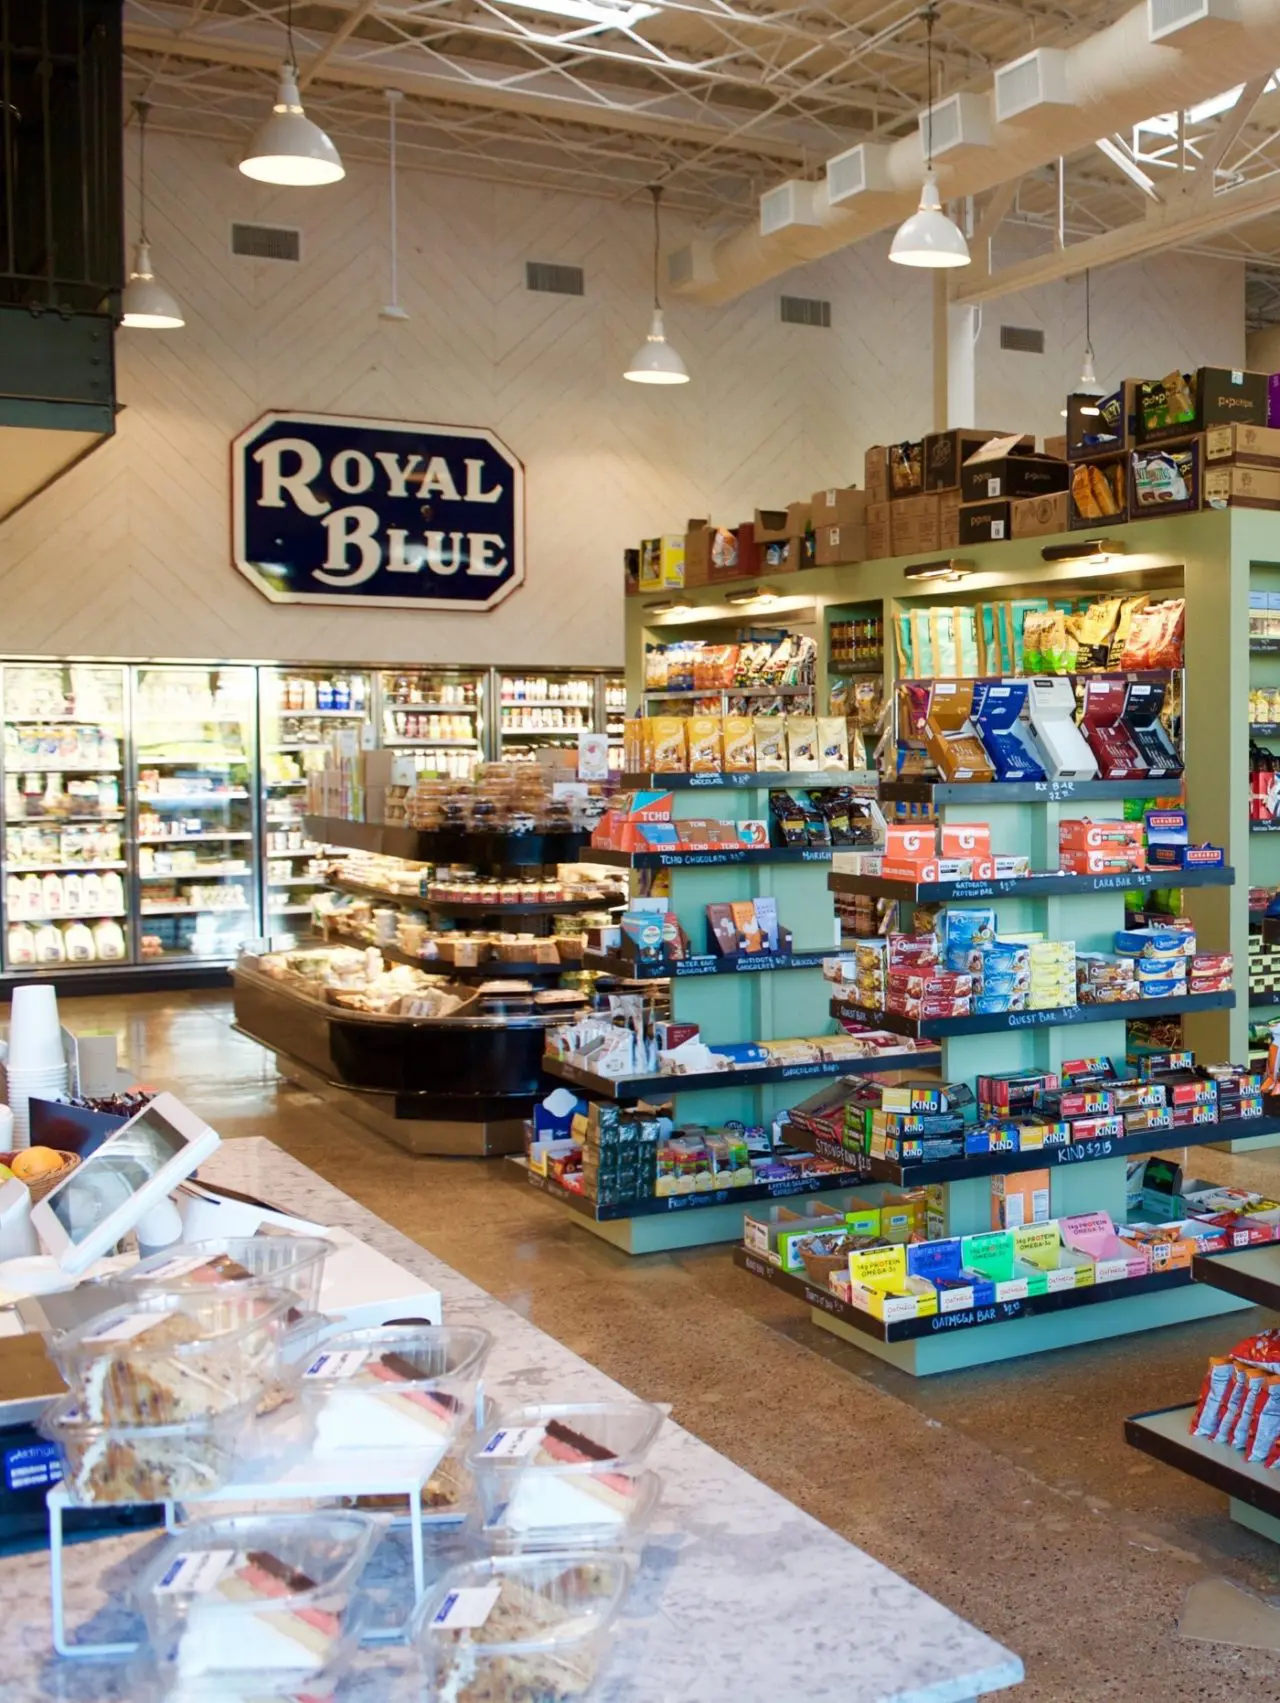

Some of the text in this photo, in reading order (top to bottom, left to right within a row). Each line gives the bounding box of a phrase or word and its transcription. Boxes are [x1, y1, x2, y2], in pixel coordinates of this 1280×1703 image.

[252, 438, 503, 516] ROYAL
[311, 505, 508, 587] BLUE
[1052, 782, 1075, 791] BAR
[641, 811, 670, 822] TCHO
[661, 855, 682, 865] TCHO
[1094, 878, 1131, 888] LARA BAR
[1008, 1011, 1056, 1026] QUEST BAR
[1086, 1062, 1109, 1071] KIND
[1170, 1060, 1192, 1070] KIND
[1239, 1083, 1262, 1096] KIND
[1138, 1094, 1163, 1105] KIND
[1195, 1091, 1218, 1101] KIND
[911, 1100, 938, 1111] KIND
[1085, 1102, 1109, 1113] KIND
[1240, 1106, 1263, 1117] KIND
[1148, 1116, 1170, 1127] KIND
[1193, 1113, 1215, 1124] KIND
[904, 1123, 924, 1132] KIND
[1095, 1125, 1118, 1136] KIND
[1043, 1133, 1066, 1144] KIND
[989, 1140, 1014, 1151] KIND
[903, 1148, 923, 1158] KIND
[1058, 1145, 1085, 1163] KIND
[1079, 1219, 1108, 1229] PROTEIN
[1029, 1233, 1056, 1243] PROTEIN
[869, 1258, 901, 1269] PROTEIN
[932, 1310, 996, 1330] OATMEGA BAR
